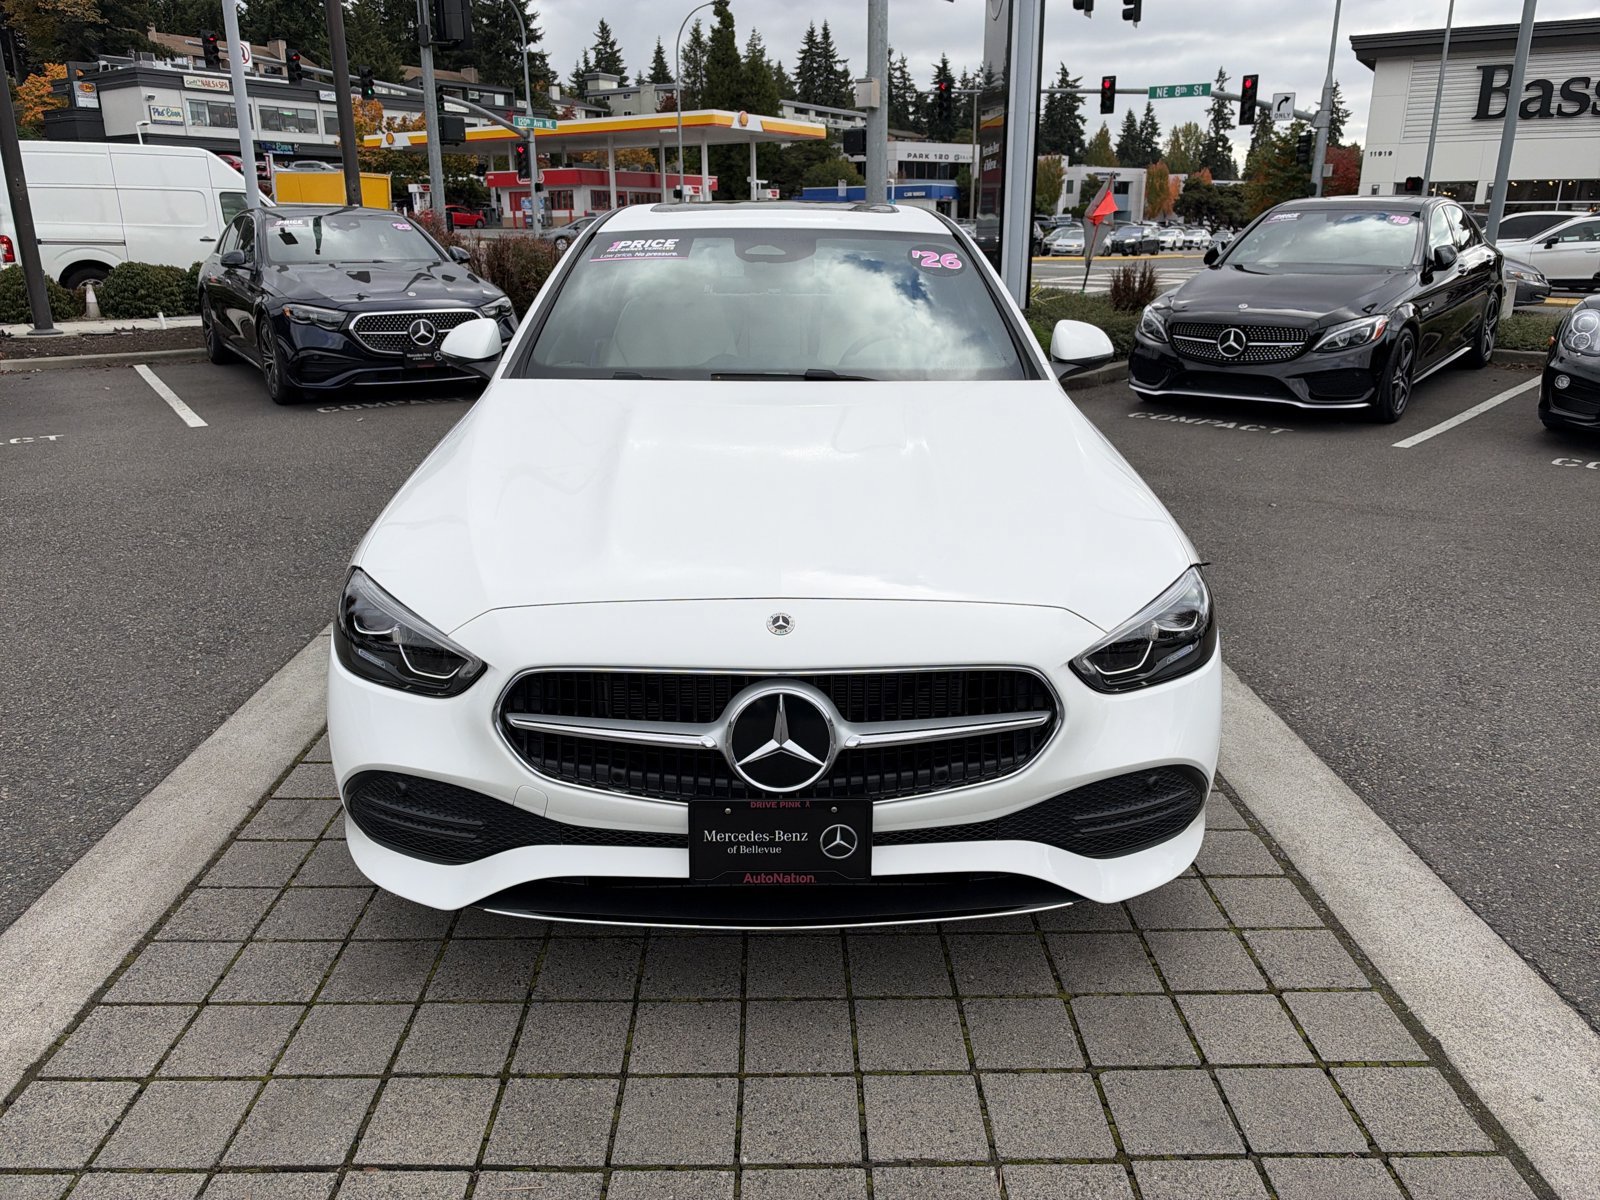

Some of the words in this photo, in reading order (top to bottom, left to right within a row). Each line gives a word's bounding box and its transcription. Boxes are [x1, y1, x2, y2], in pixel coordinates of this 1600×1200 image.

[1156, 87, 1168, 97] NE
[1174, 86, 1187, 97] 8th
[1193, 85, 1203, 96] St
[518, 117, 530, 126] 120th
[534, 119, 543, 127] Ave
[546, 120, 553, 128] NE
[907, 152, 929, 160] PARK
[912, 250, 963, 269] '26
[1127, 412, 1294, 434] COMPACT
[703, 830, 808, 842] Mercedes-Benz
[727, 845, 737, 854] of
[740, 845, 782, 854] Bellevue
[743, 873, 815, 884] AutoNation
